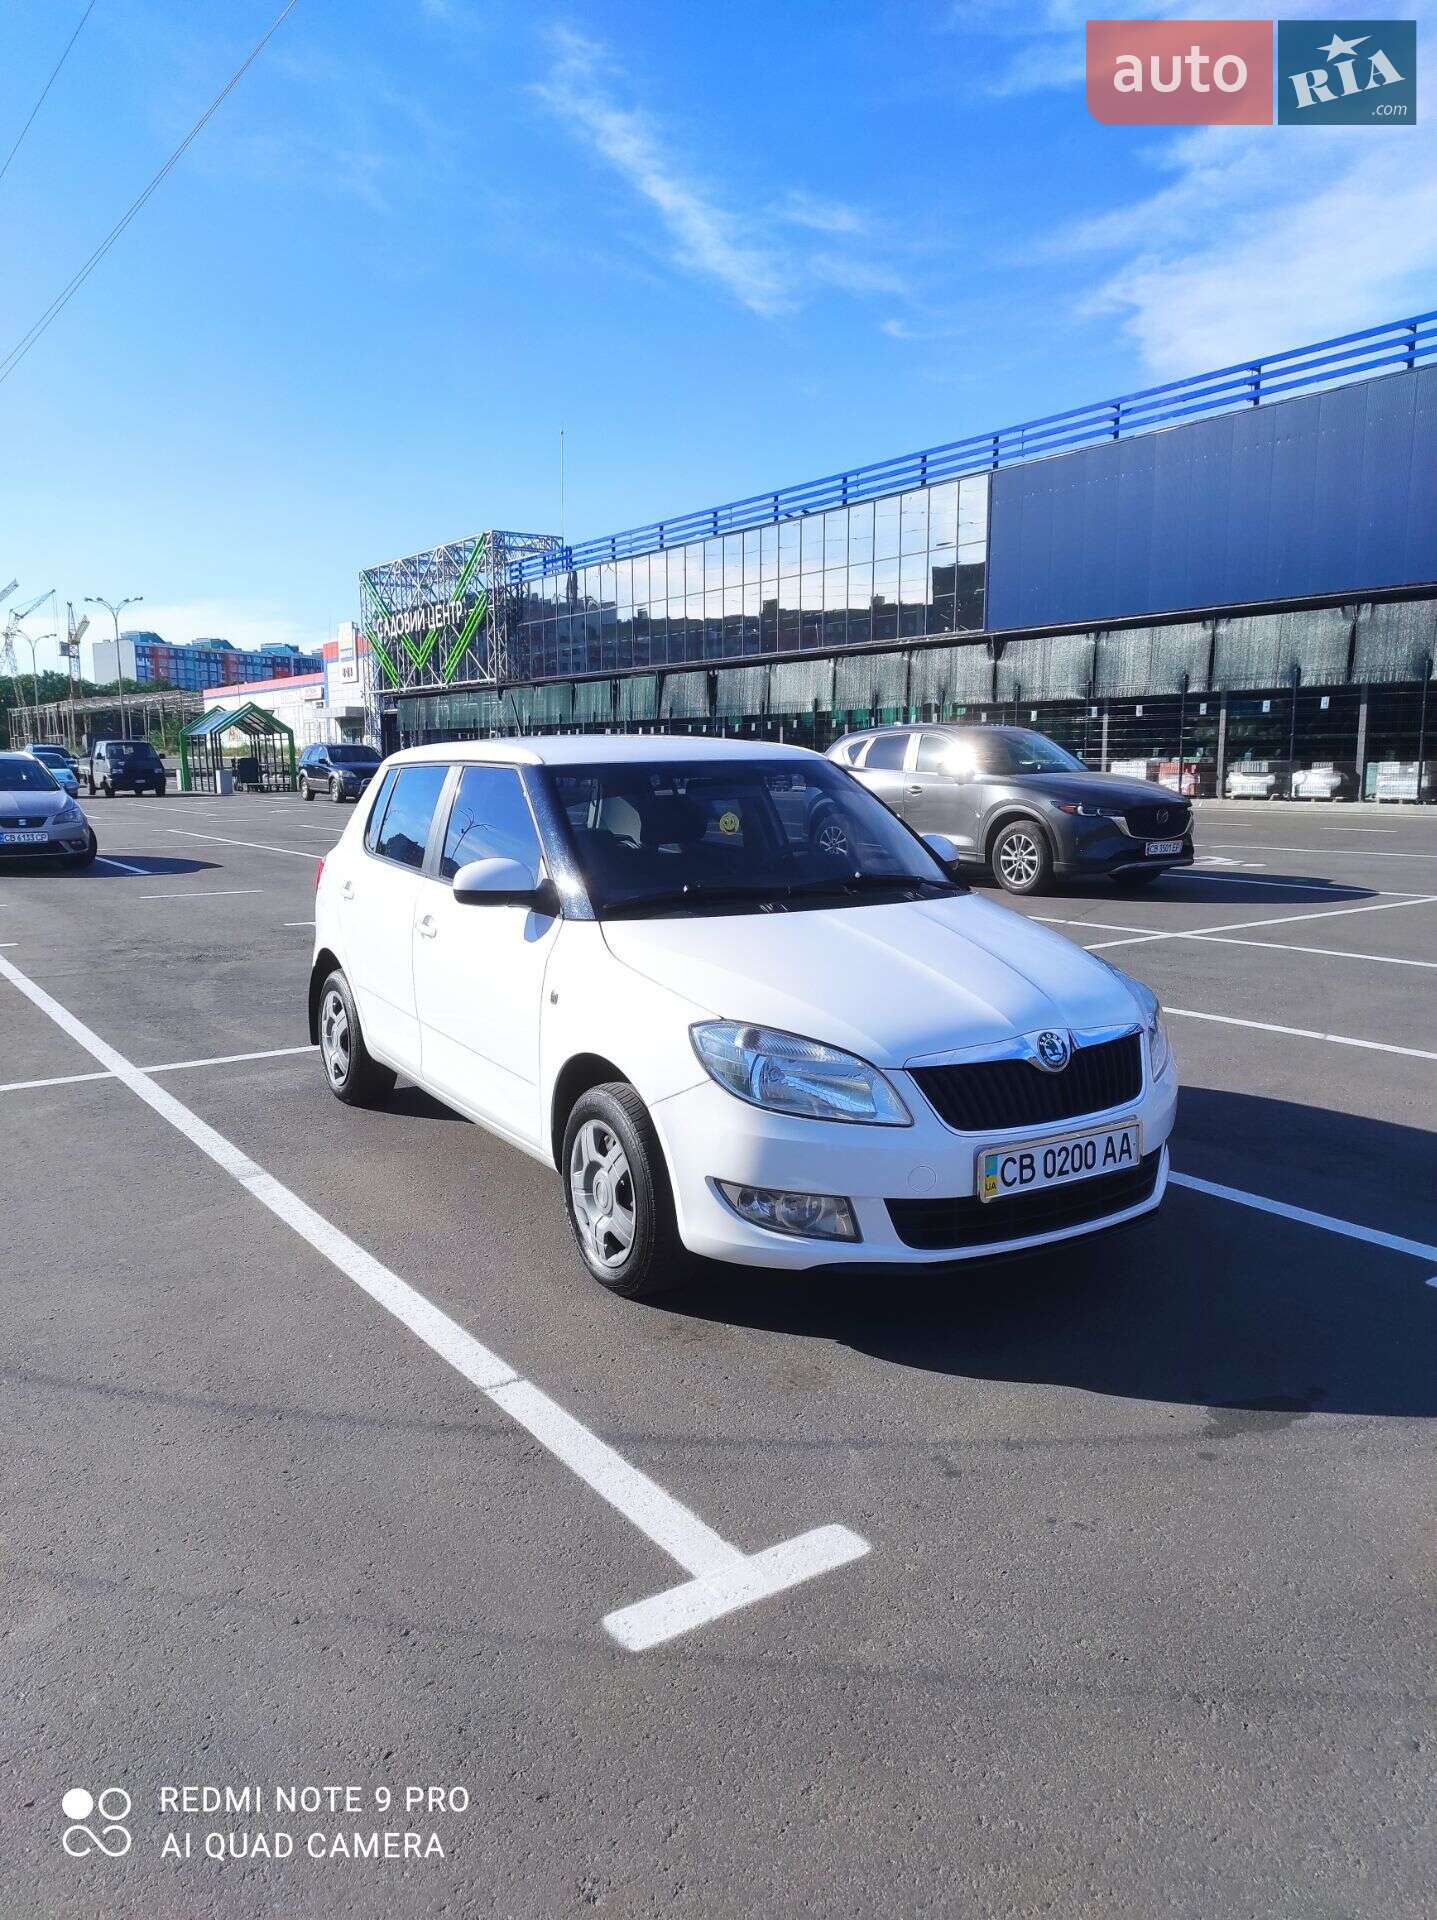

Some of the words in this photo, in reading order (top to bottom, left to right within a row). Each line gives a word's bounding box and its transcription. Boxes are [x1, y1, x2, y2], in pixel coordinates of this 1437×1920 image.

[377, 607, 425, 638] САДОВИЙ
[427, 600, 463, 631] ЦЕНТР
[1000, 1153, 1036, 1187] CB
[1043, 1140, 1096, 1179] 0200
[1102, 1132, 1133, 1166] AA
[985, 1182, 997, 1191] UA
